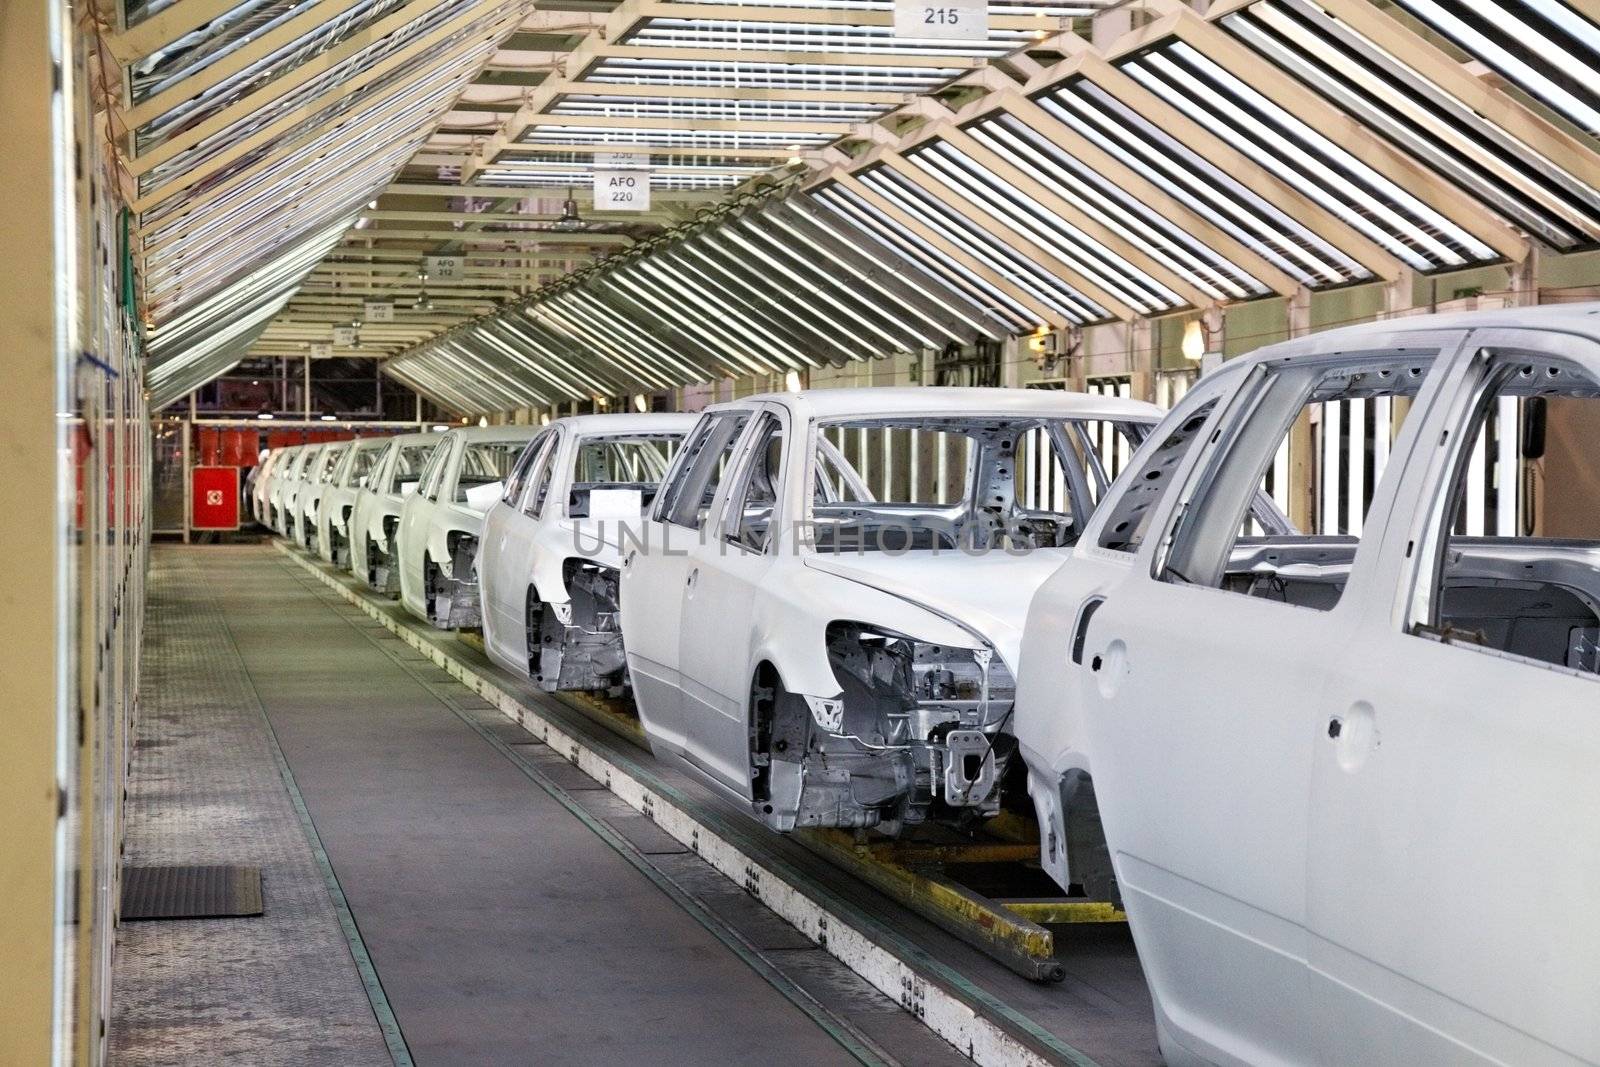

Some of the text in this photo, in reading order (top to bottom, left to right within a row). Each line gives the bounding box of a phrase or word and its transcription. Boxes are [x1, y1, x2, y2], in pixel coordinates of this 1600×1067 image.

[925, 8, 958, 24] 215
[609, 177, 635, 187] AFO
[612, 192, 633, 202] 220
